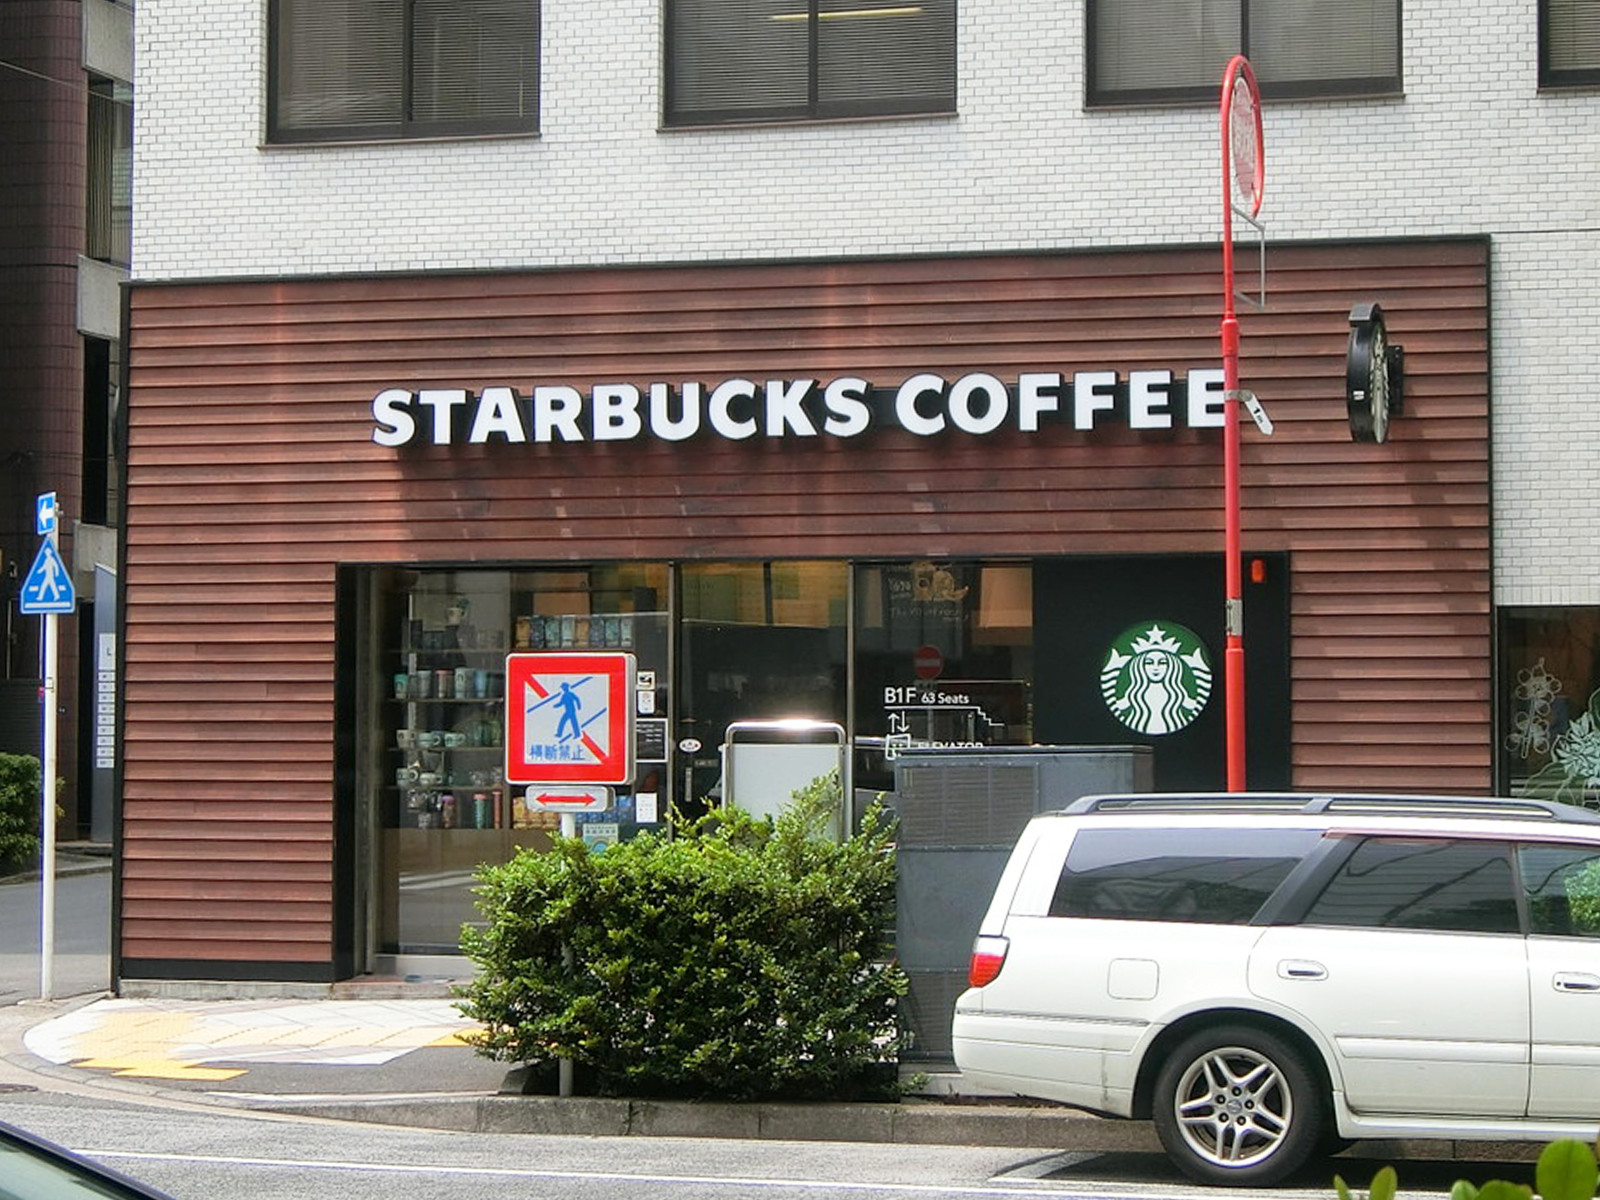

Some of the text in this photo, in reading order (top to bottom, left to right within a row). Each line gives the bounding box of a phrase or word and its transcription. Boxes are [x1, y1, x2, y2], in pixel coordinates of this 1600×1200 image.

[371, 368, 1226, 448] STARBUCKS COFFEE
[884, 687, 970, 704] B1F 63 Seats
